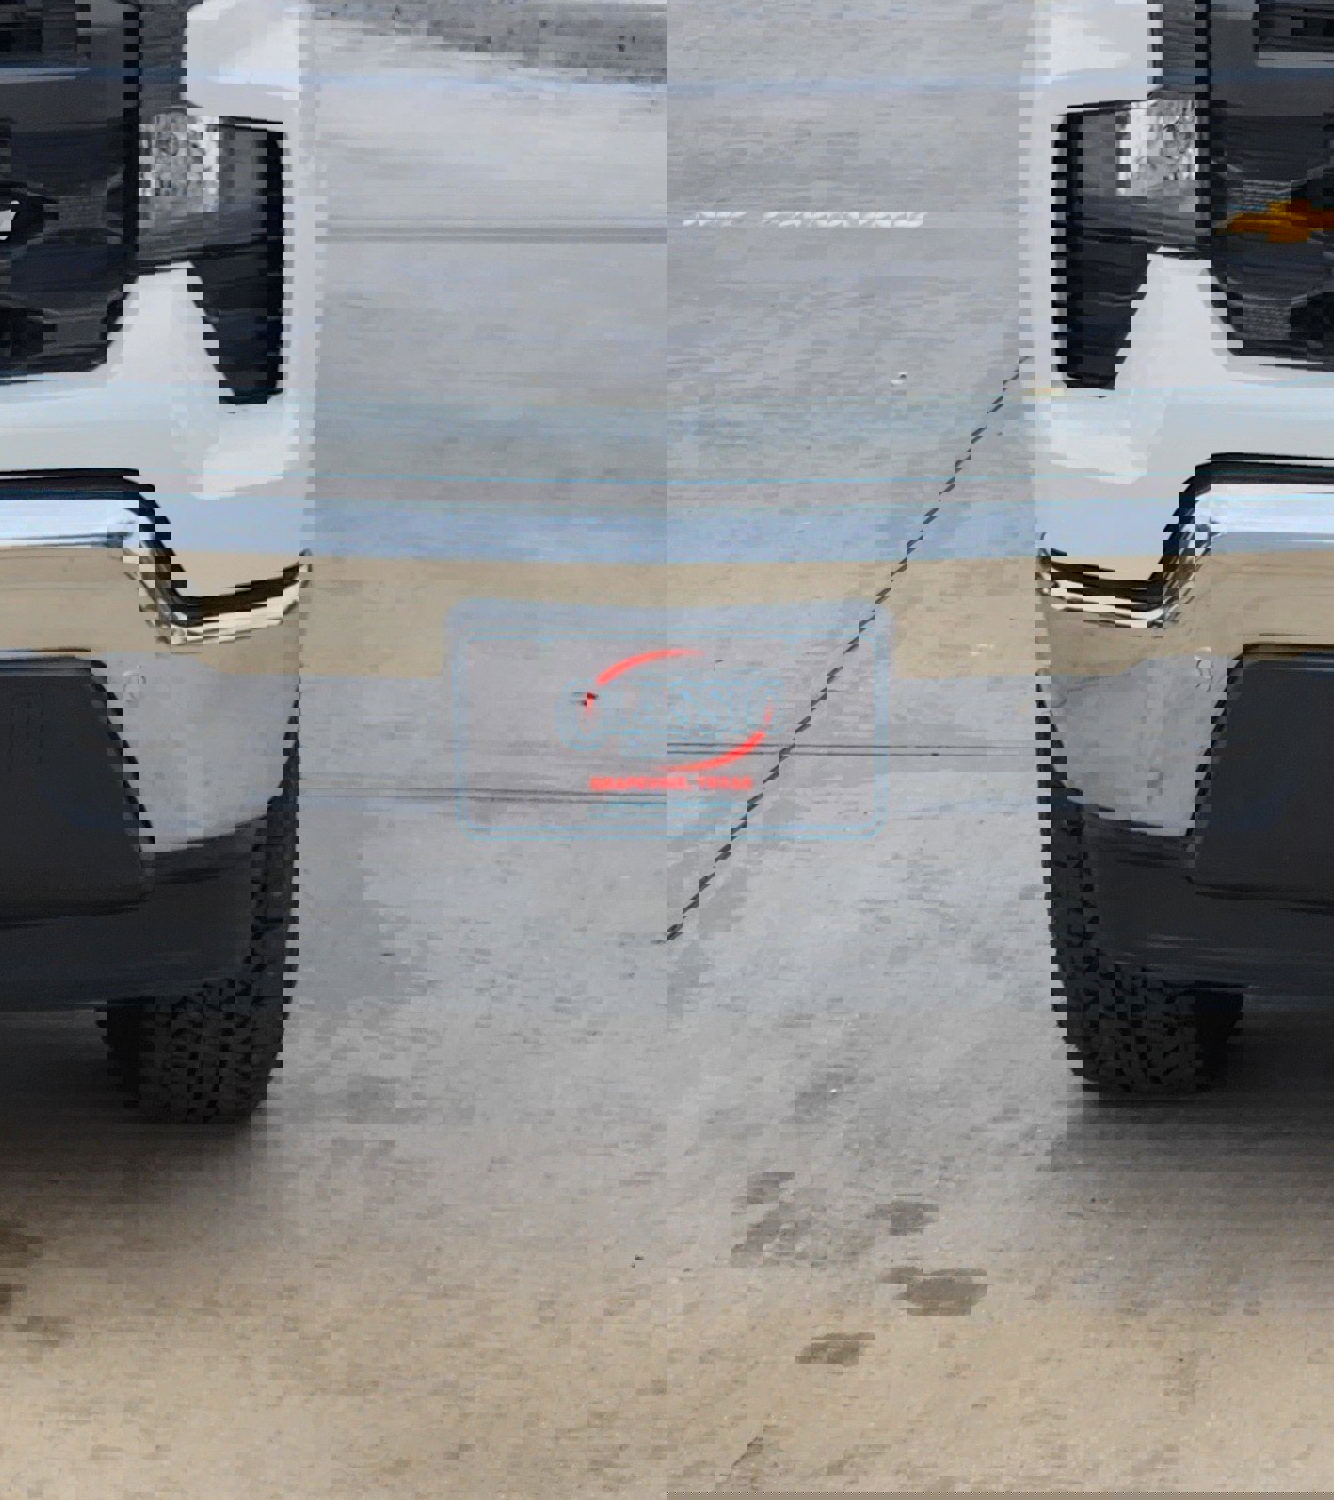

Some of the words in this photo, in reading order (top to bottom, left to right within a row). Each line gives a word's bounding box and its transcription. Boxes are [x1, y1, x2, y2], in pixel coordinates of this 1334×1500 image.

[555, 678, 785, 750] CLASSIC
[620, 732, 725, 758] Chevrolet
[696, 775, 754, 790] TEXAS
